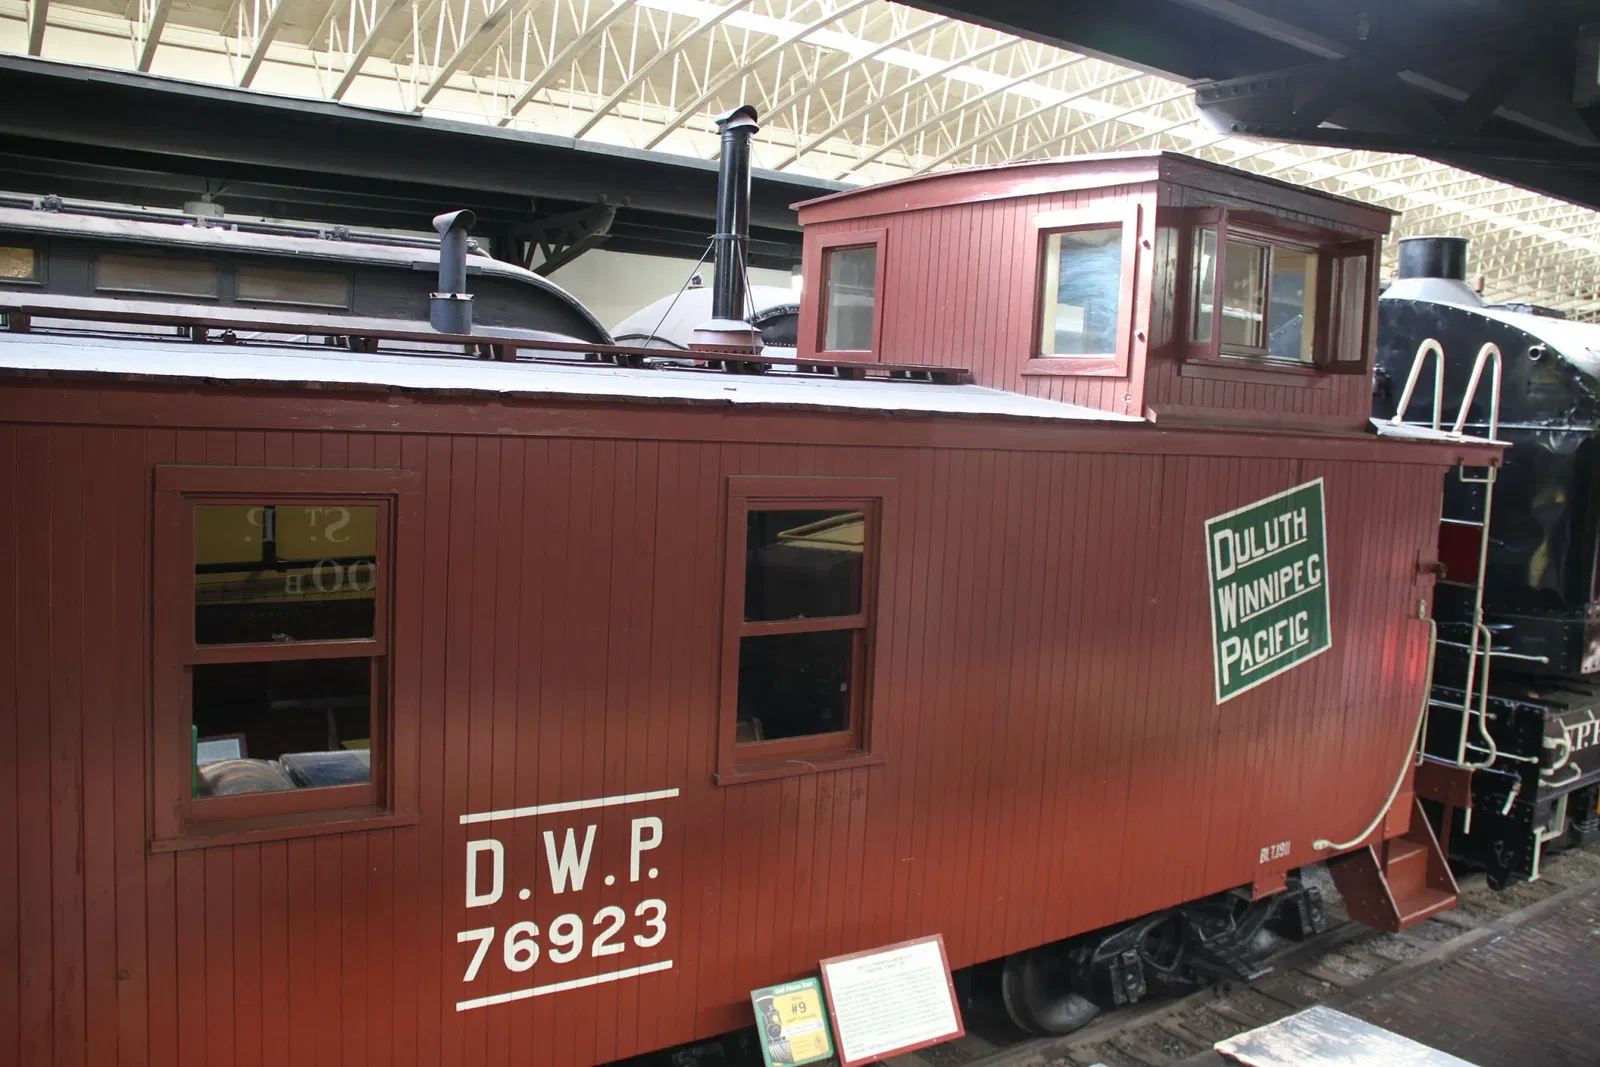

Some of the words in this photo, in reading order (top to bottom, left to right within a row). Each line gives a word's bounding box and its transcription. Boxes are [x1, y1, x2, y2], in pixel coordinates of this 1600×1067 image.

[1213, 507, 1307, 581] DULUTH
[1218, 553, 1321, 632] WINNIPEG
[1221, 610, 1309, 686] PACIFIC
[457, 898, 667, 982] 76923
[791, 1001, 807, 1015] #9
